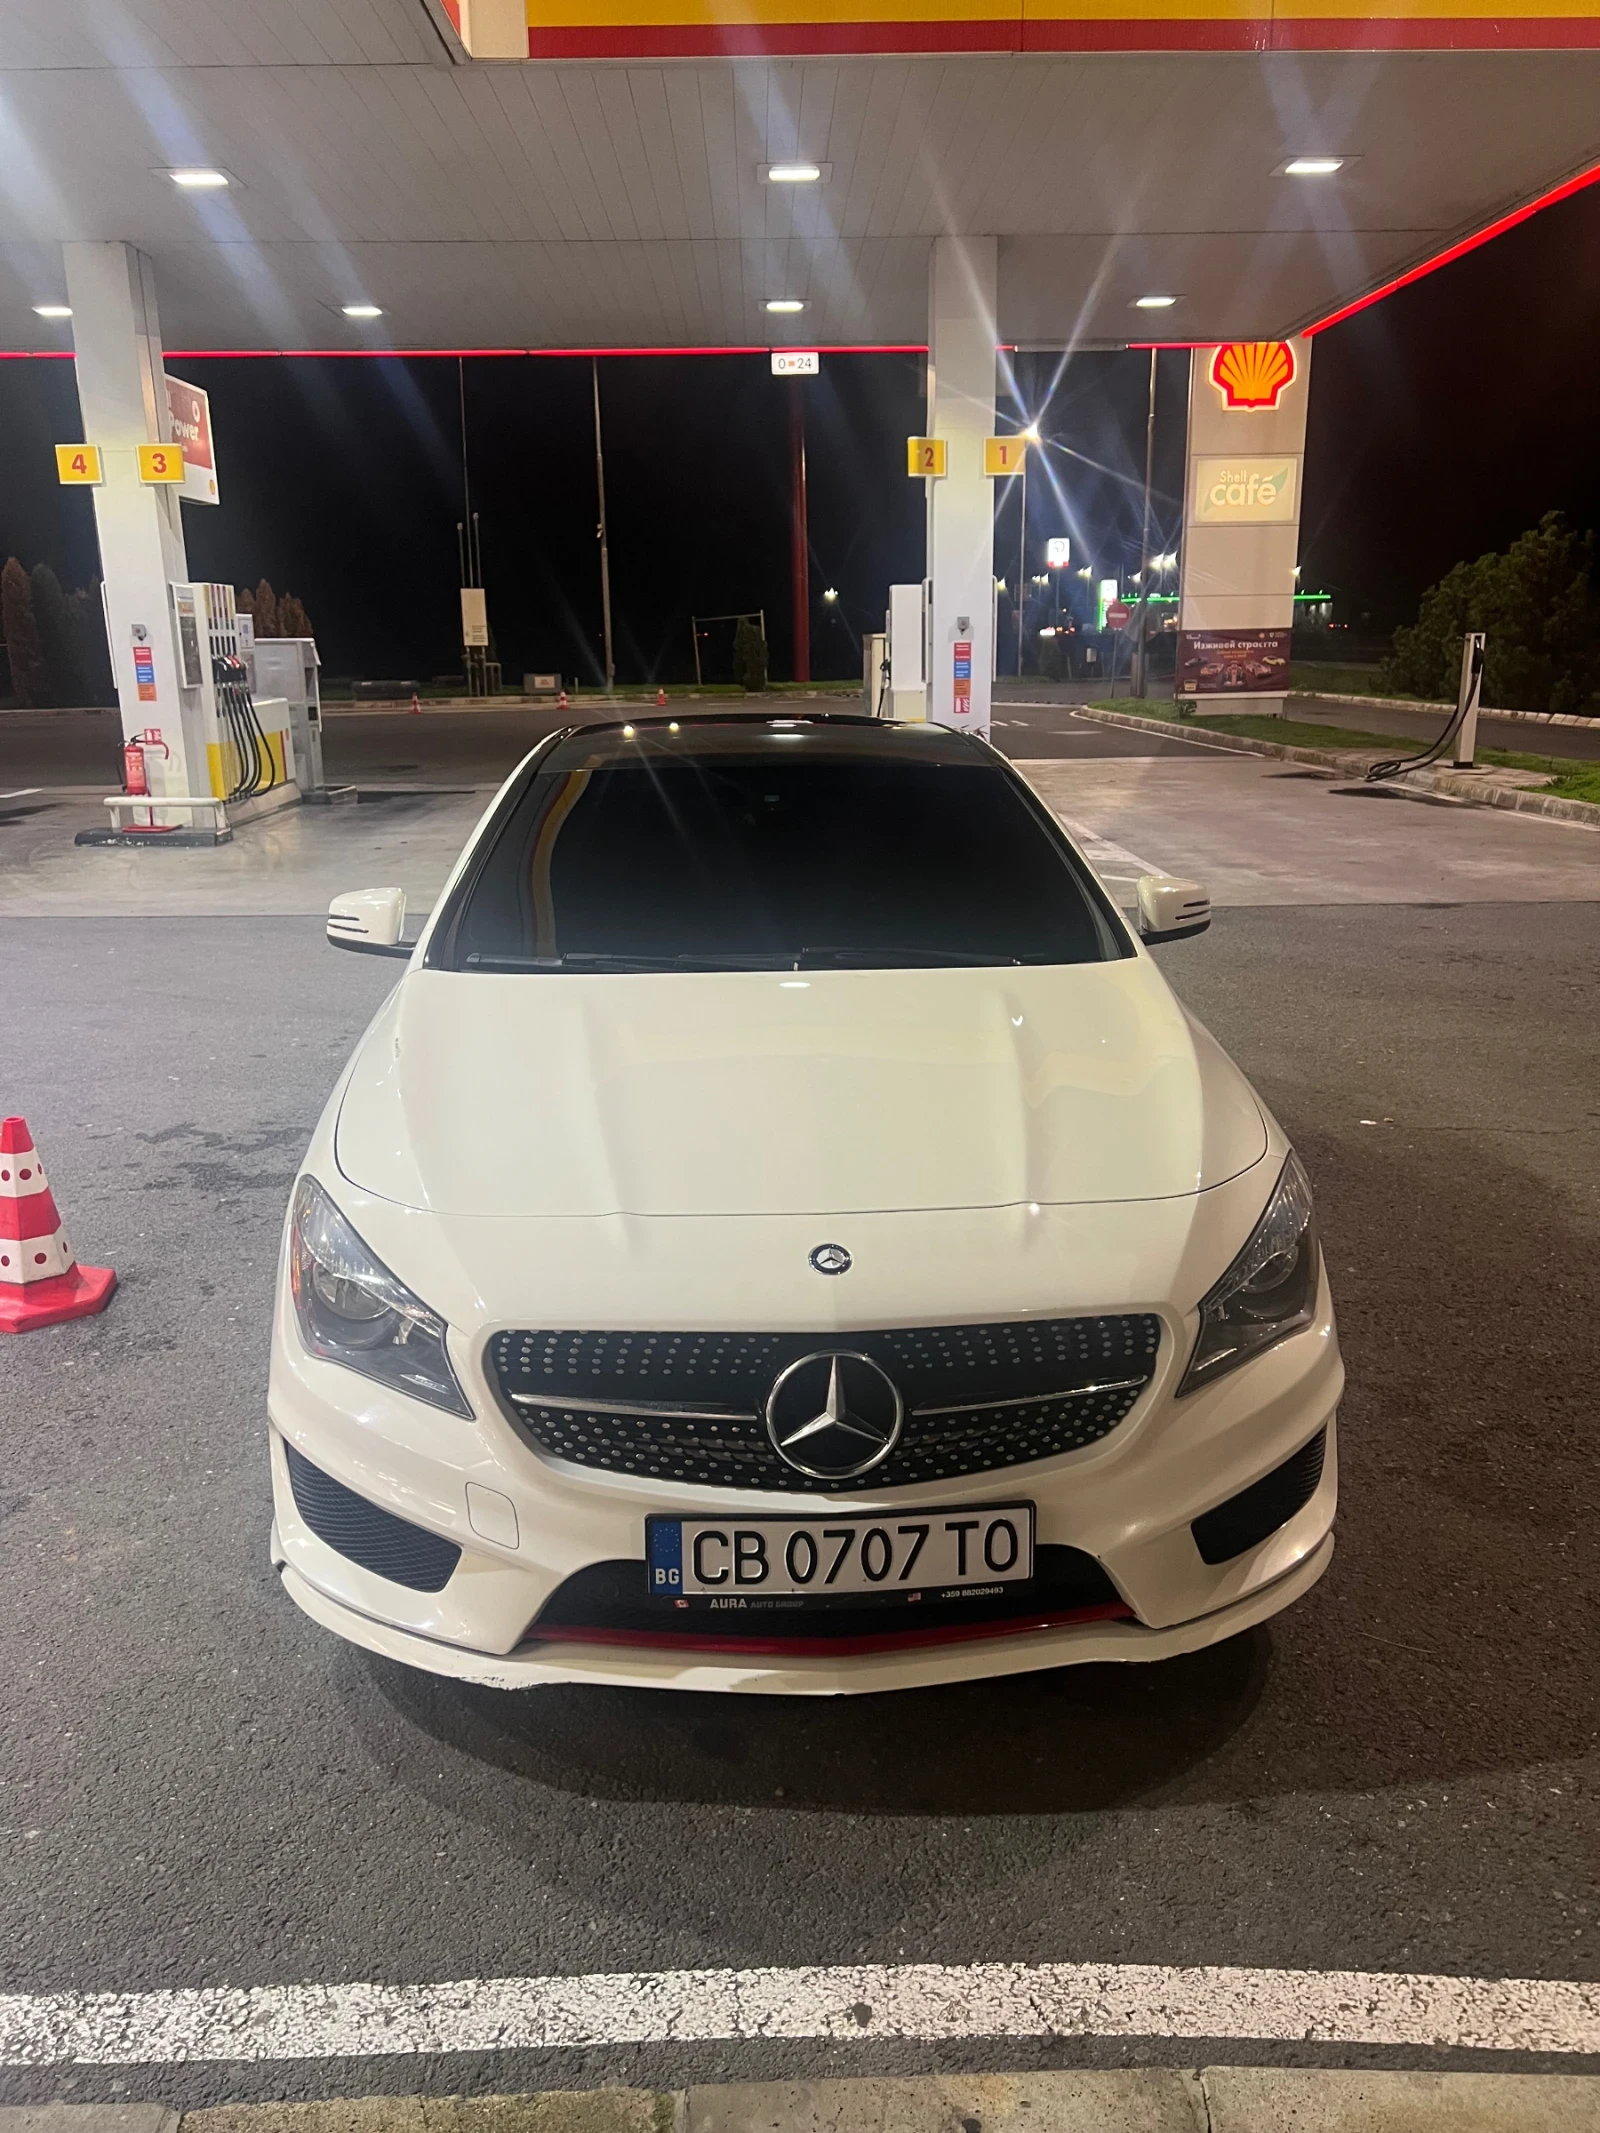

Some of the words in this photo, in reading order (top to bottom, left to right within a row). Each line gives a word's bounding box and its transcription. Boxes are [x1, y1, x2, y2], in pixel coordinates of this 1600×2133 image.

[71, 454, 87, 474] 4
[152, 453, 167, 474] 3
[925, 447, 934, 467] 2
[999, 446, 1007, 465] 1
[1219, 469, 1247, 483] Shell
[1209, 473, 1277, 507] café
[693, 1530, 769, 1585] CB
[784, 1524, 930, 1585] 0707
[655, 1568, 680, 1585] BG
[709, 1598, 748, 1609] AURA
